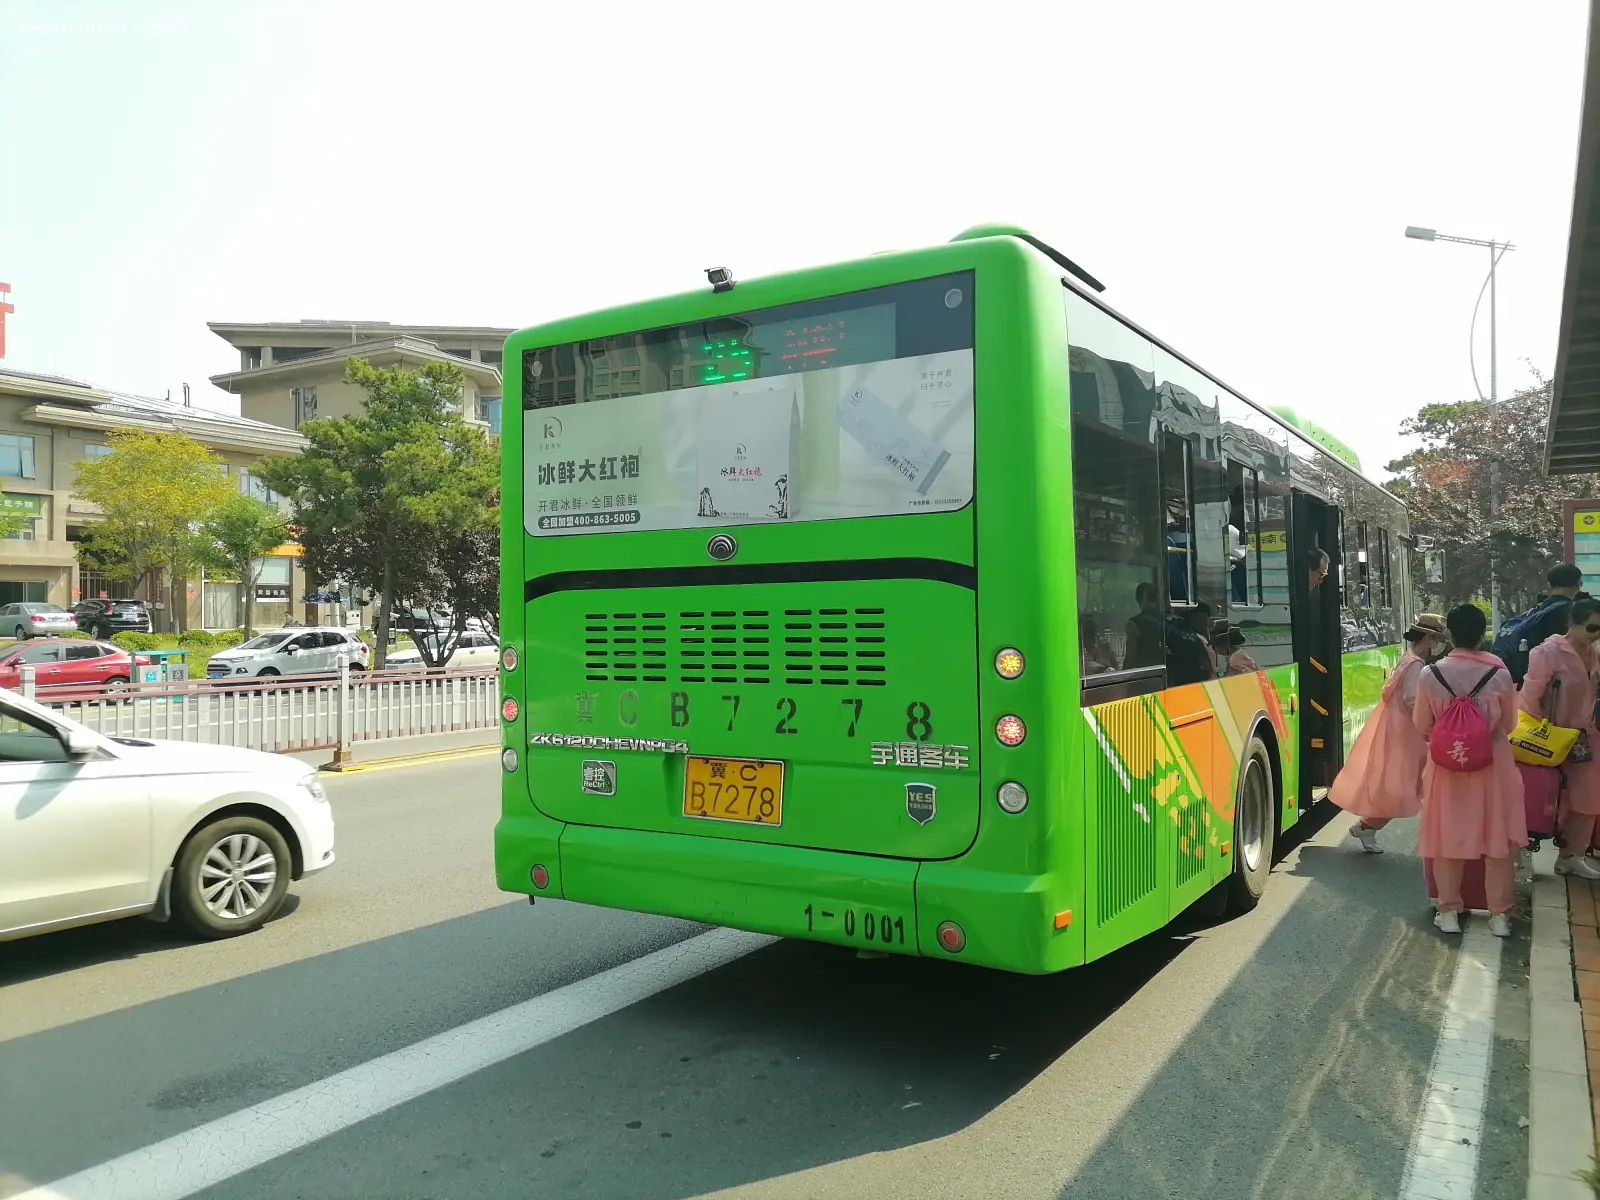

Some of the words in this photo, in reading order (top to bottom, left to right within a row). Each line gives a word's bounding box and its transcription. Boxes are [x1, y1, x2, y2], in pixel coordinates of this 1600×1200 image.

[538, 454, 640, 486] 冰鲜大红袍
[720, 466, 763, 477] 冰鲜大红袍
[870, 741, 970, 769] 宇通客车
[690, 780, 775, 818] B7278
